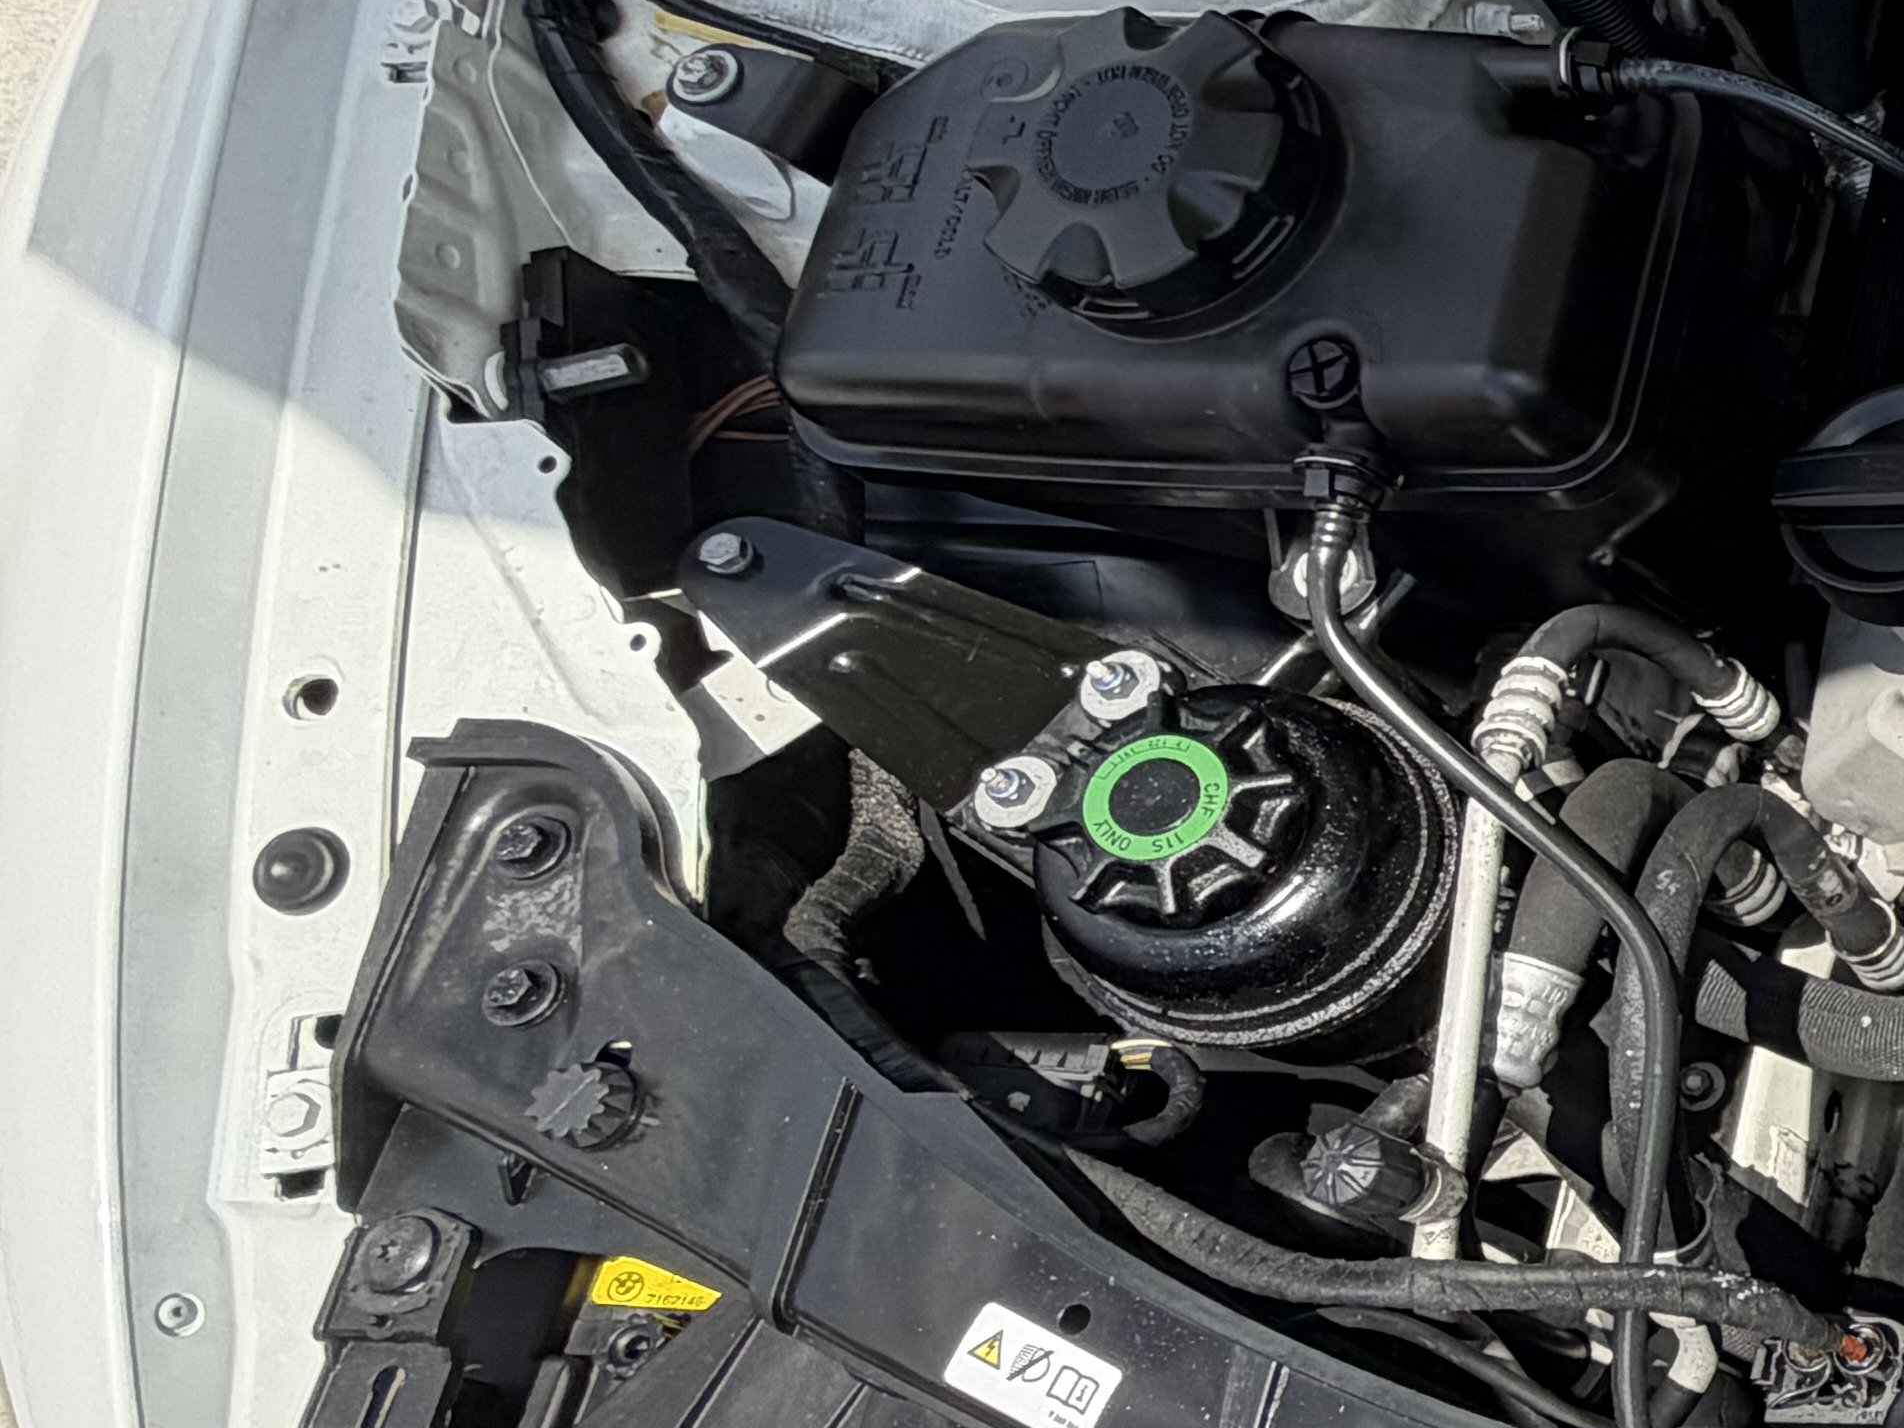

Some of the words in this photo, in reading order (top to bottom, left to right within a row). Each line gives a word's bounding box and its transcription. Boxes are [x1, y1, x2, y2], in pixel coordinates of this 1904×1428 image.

[1200, 782, 1220, 818] CHF
[1092, 819, 1132, 852] ONLY
[1152, 831, 1185, 853] 11S
